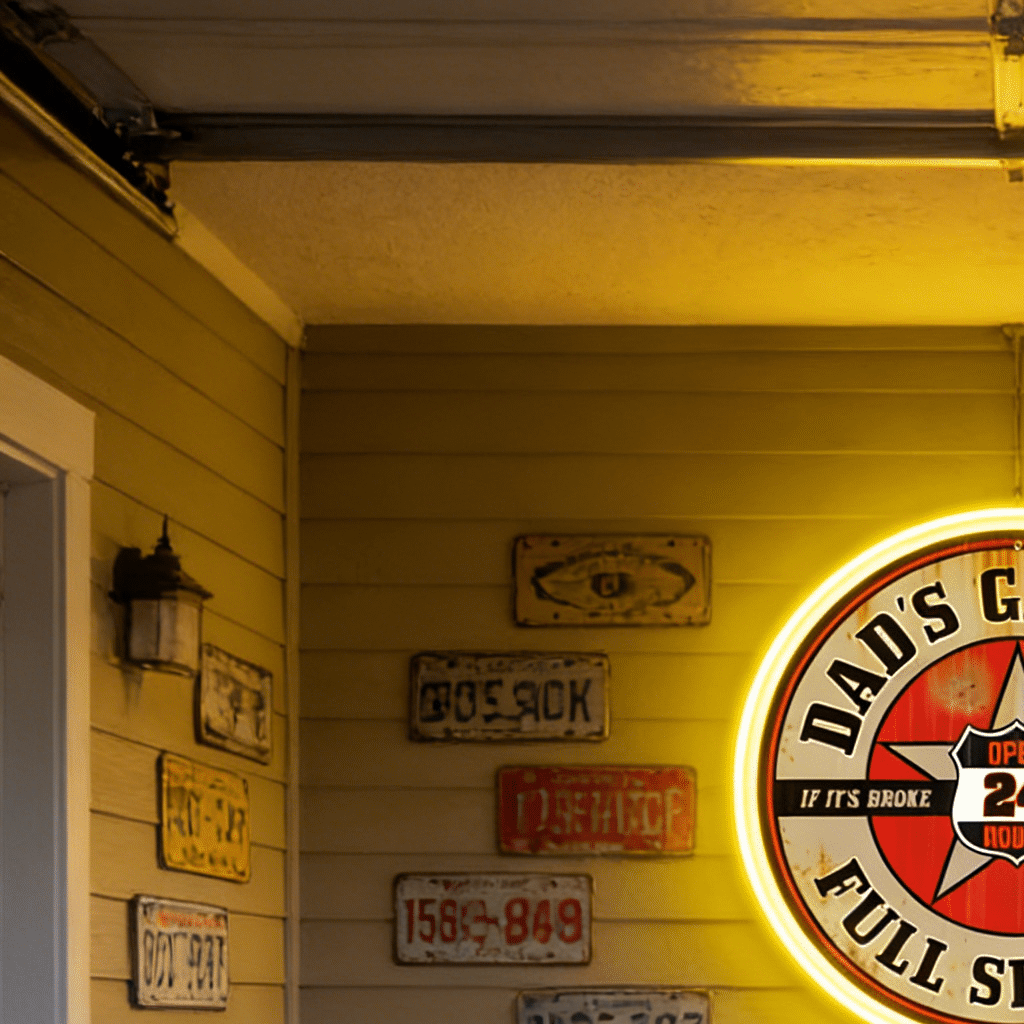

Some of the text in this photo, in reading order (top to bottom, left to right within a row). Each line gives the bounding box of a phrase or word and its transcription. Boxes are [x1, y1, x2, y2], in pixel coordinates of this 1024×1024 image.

[800, 582, 960, 755] DAD'S
[800, 788, 932, 808] IF IT'S BROKE
[813, 858, 948, 993] FULL
